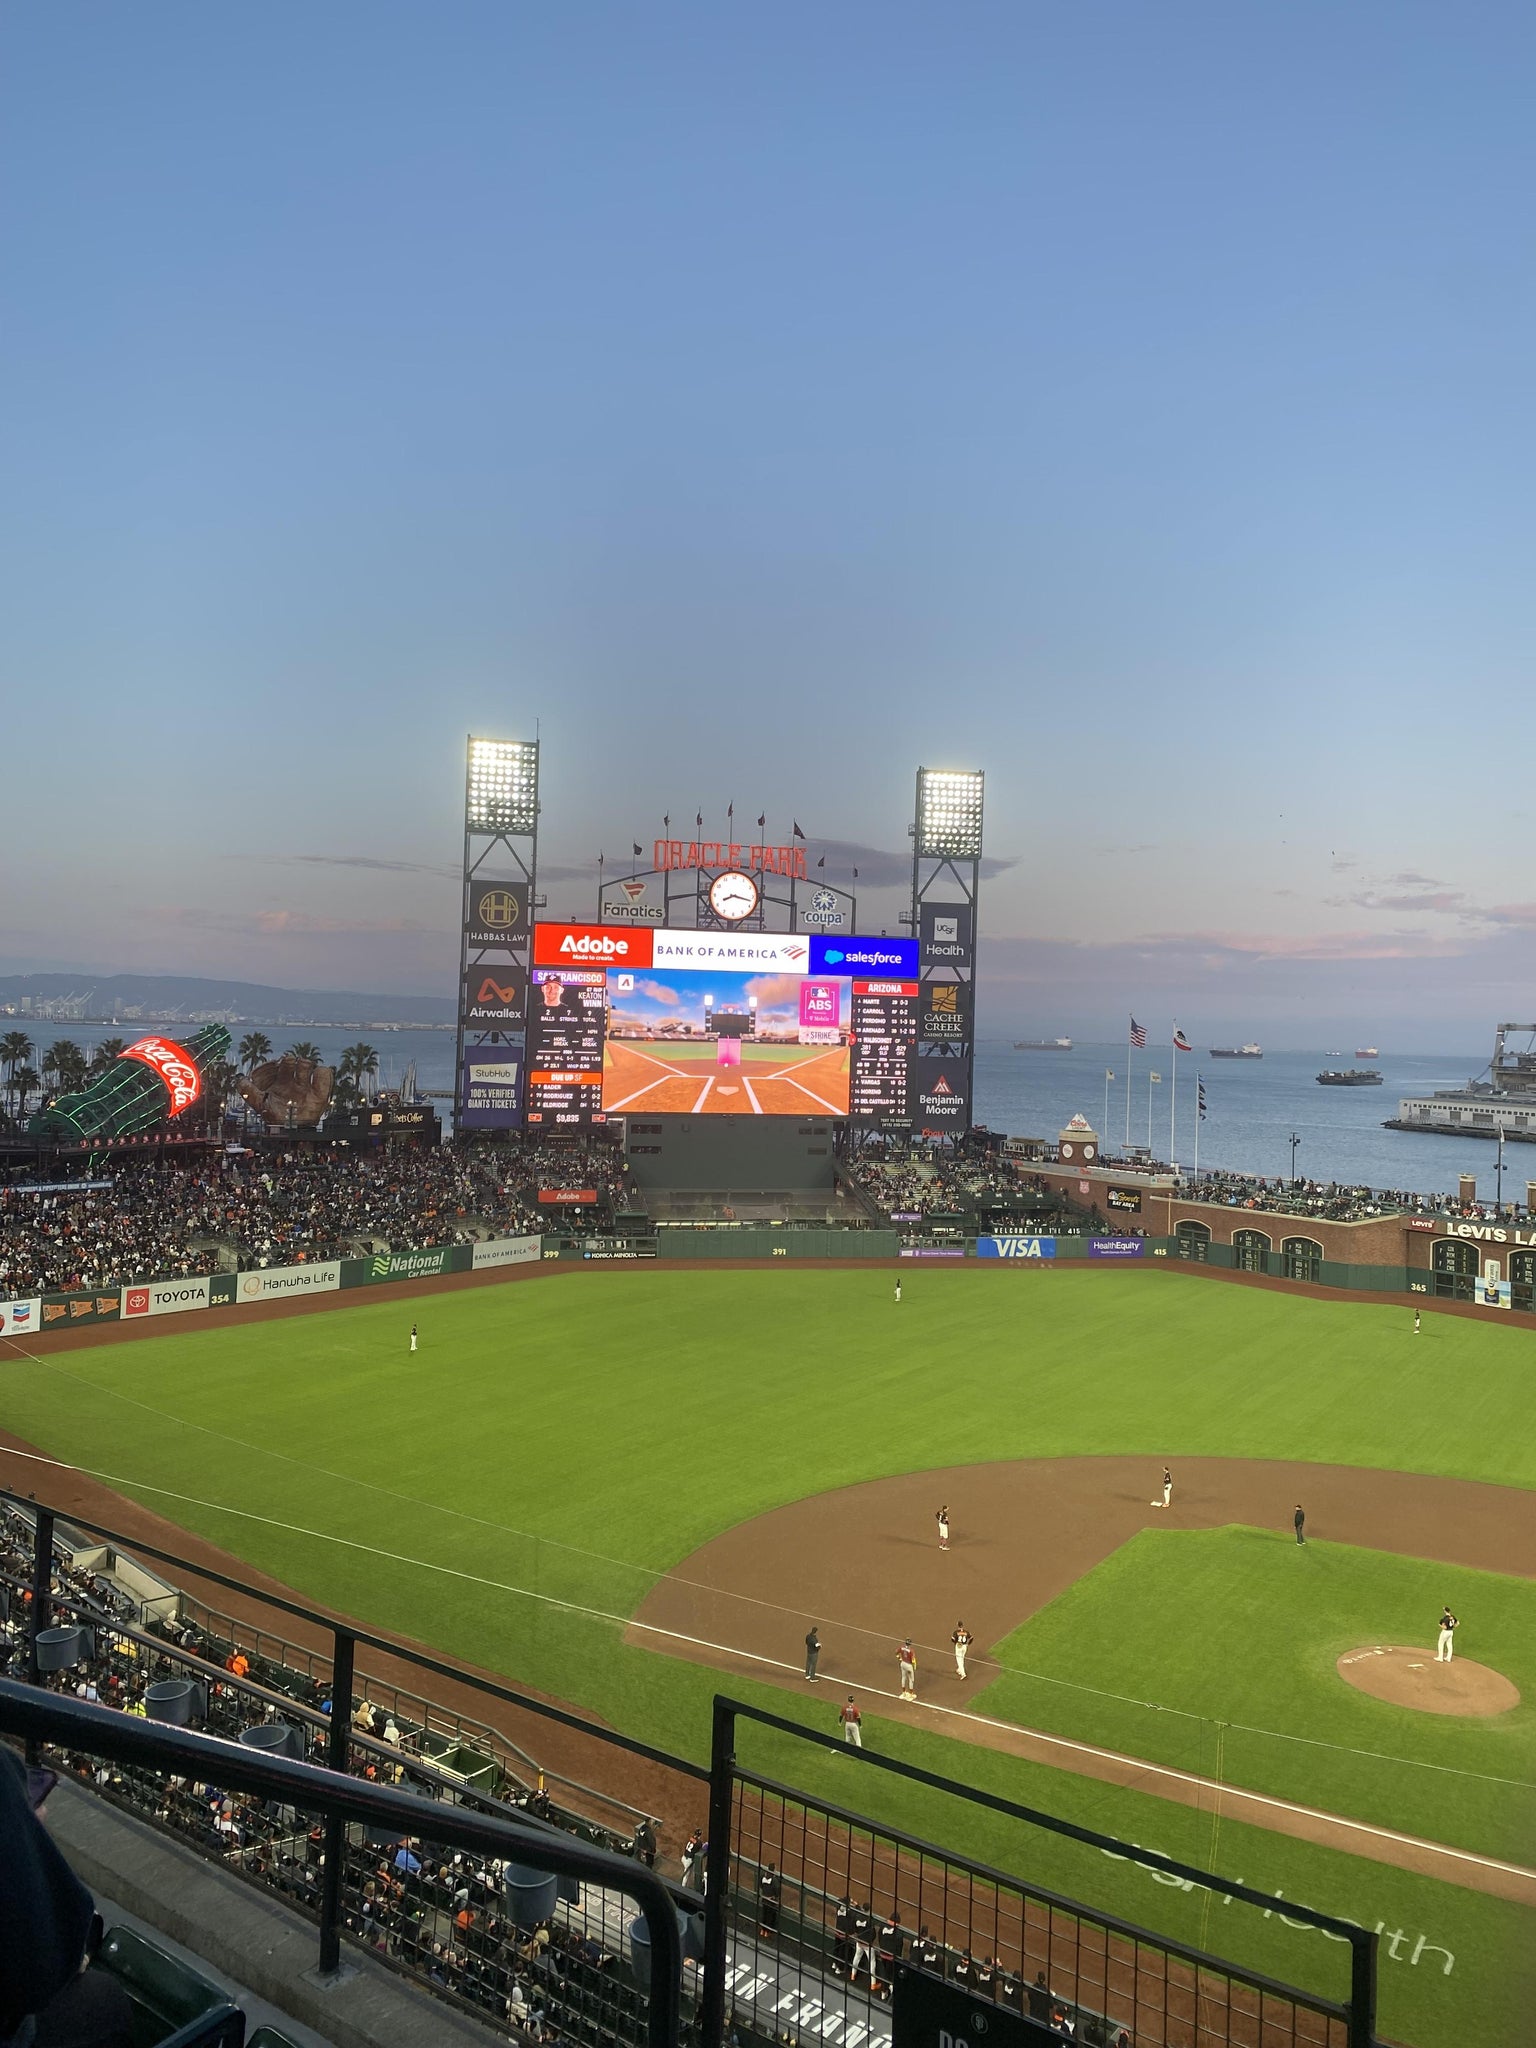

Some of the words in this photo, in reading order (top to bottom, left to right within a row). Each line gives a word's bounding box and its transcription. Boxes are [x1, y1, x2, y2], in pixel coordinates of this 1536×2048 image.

[654, 840, 741, 871] ORACLE
[750, 845, 807, 880] PARK
[603, 902, 663, 918] Fanatics
[805, 911, 842, 925] coupa
[471, 932, 505, 941] HABBAS
[506, 934, 525, 942] LAW
[560, 935, 628, 954] Adobe
[658, 946, 693, 955] BANK
[698, 947, 714, 956] OF
[718, 948, 777, 958] AMERICA
[926, 944, 964, 956] Health
[846, 951, 902, 964] salesforce
[868, 984, 902, 993] ARIZONA
[808, 1000, 832, 1010] ABS
[470, 1008, 521, 1019] Airwallex
[924, 1014, 963, 1022] CACHE
[925, 1022, 962, 1032] CREEK
[475, 1069, 511, 1078] StubHub
[470, 1089, 487, 1098] 100%
[488, 1089, 515, 1099] VERIFIED
[468, 1099, 490, 1109] GIANTS
[491, 1099, 517, 1109] TICKETS
[920, 1095, 964, 1105] Benjamin
[926, 1105, 957, 1115] Moore
[407, 1112, 423, 1124] Coffee
[556, 1114, 579, 1123] $9,835
[556, 1192, 580, 1200] Adobe
[992, 1240, 1041, 1257] VISA
[1093, 1242, 1140, 1251] HealthEquity
[500, 1248, 526, 1257] AMERICA
[773, 1248, 786, 1256] 391
[390, 1252, 445, 1272] National
[420, 1268, 441, 1276] Rental
[263, 1276, 311, 1290] Hanwha
[314, 1271, 335, 1284] Life
[1411, 1283, 1426, 1292] 365
[154, 1289, 205, 1304] TOYOTA
[212, 1294, 229, 1304] 354
